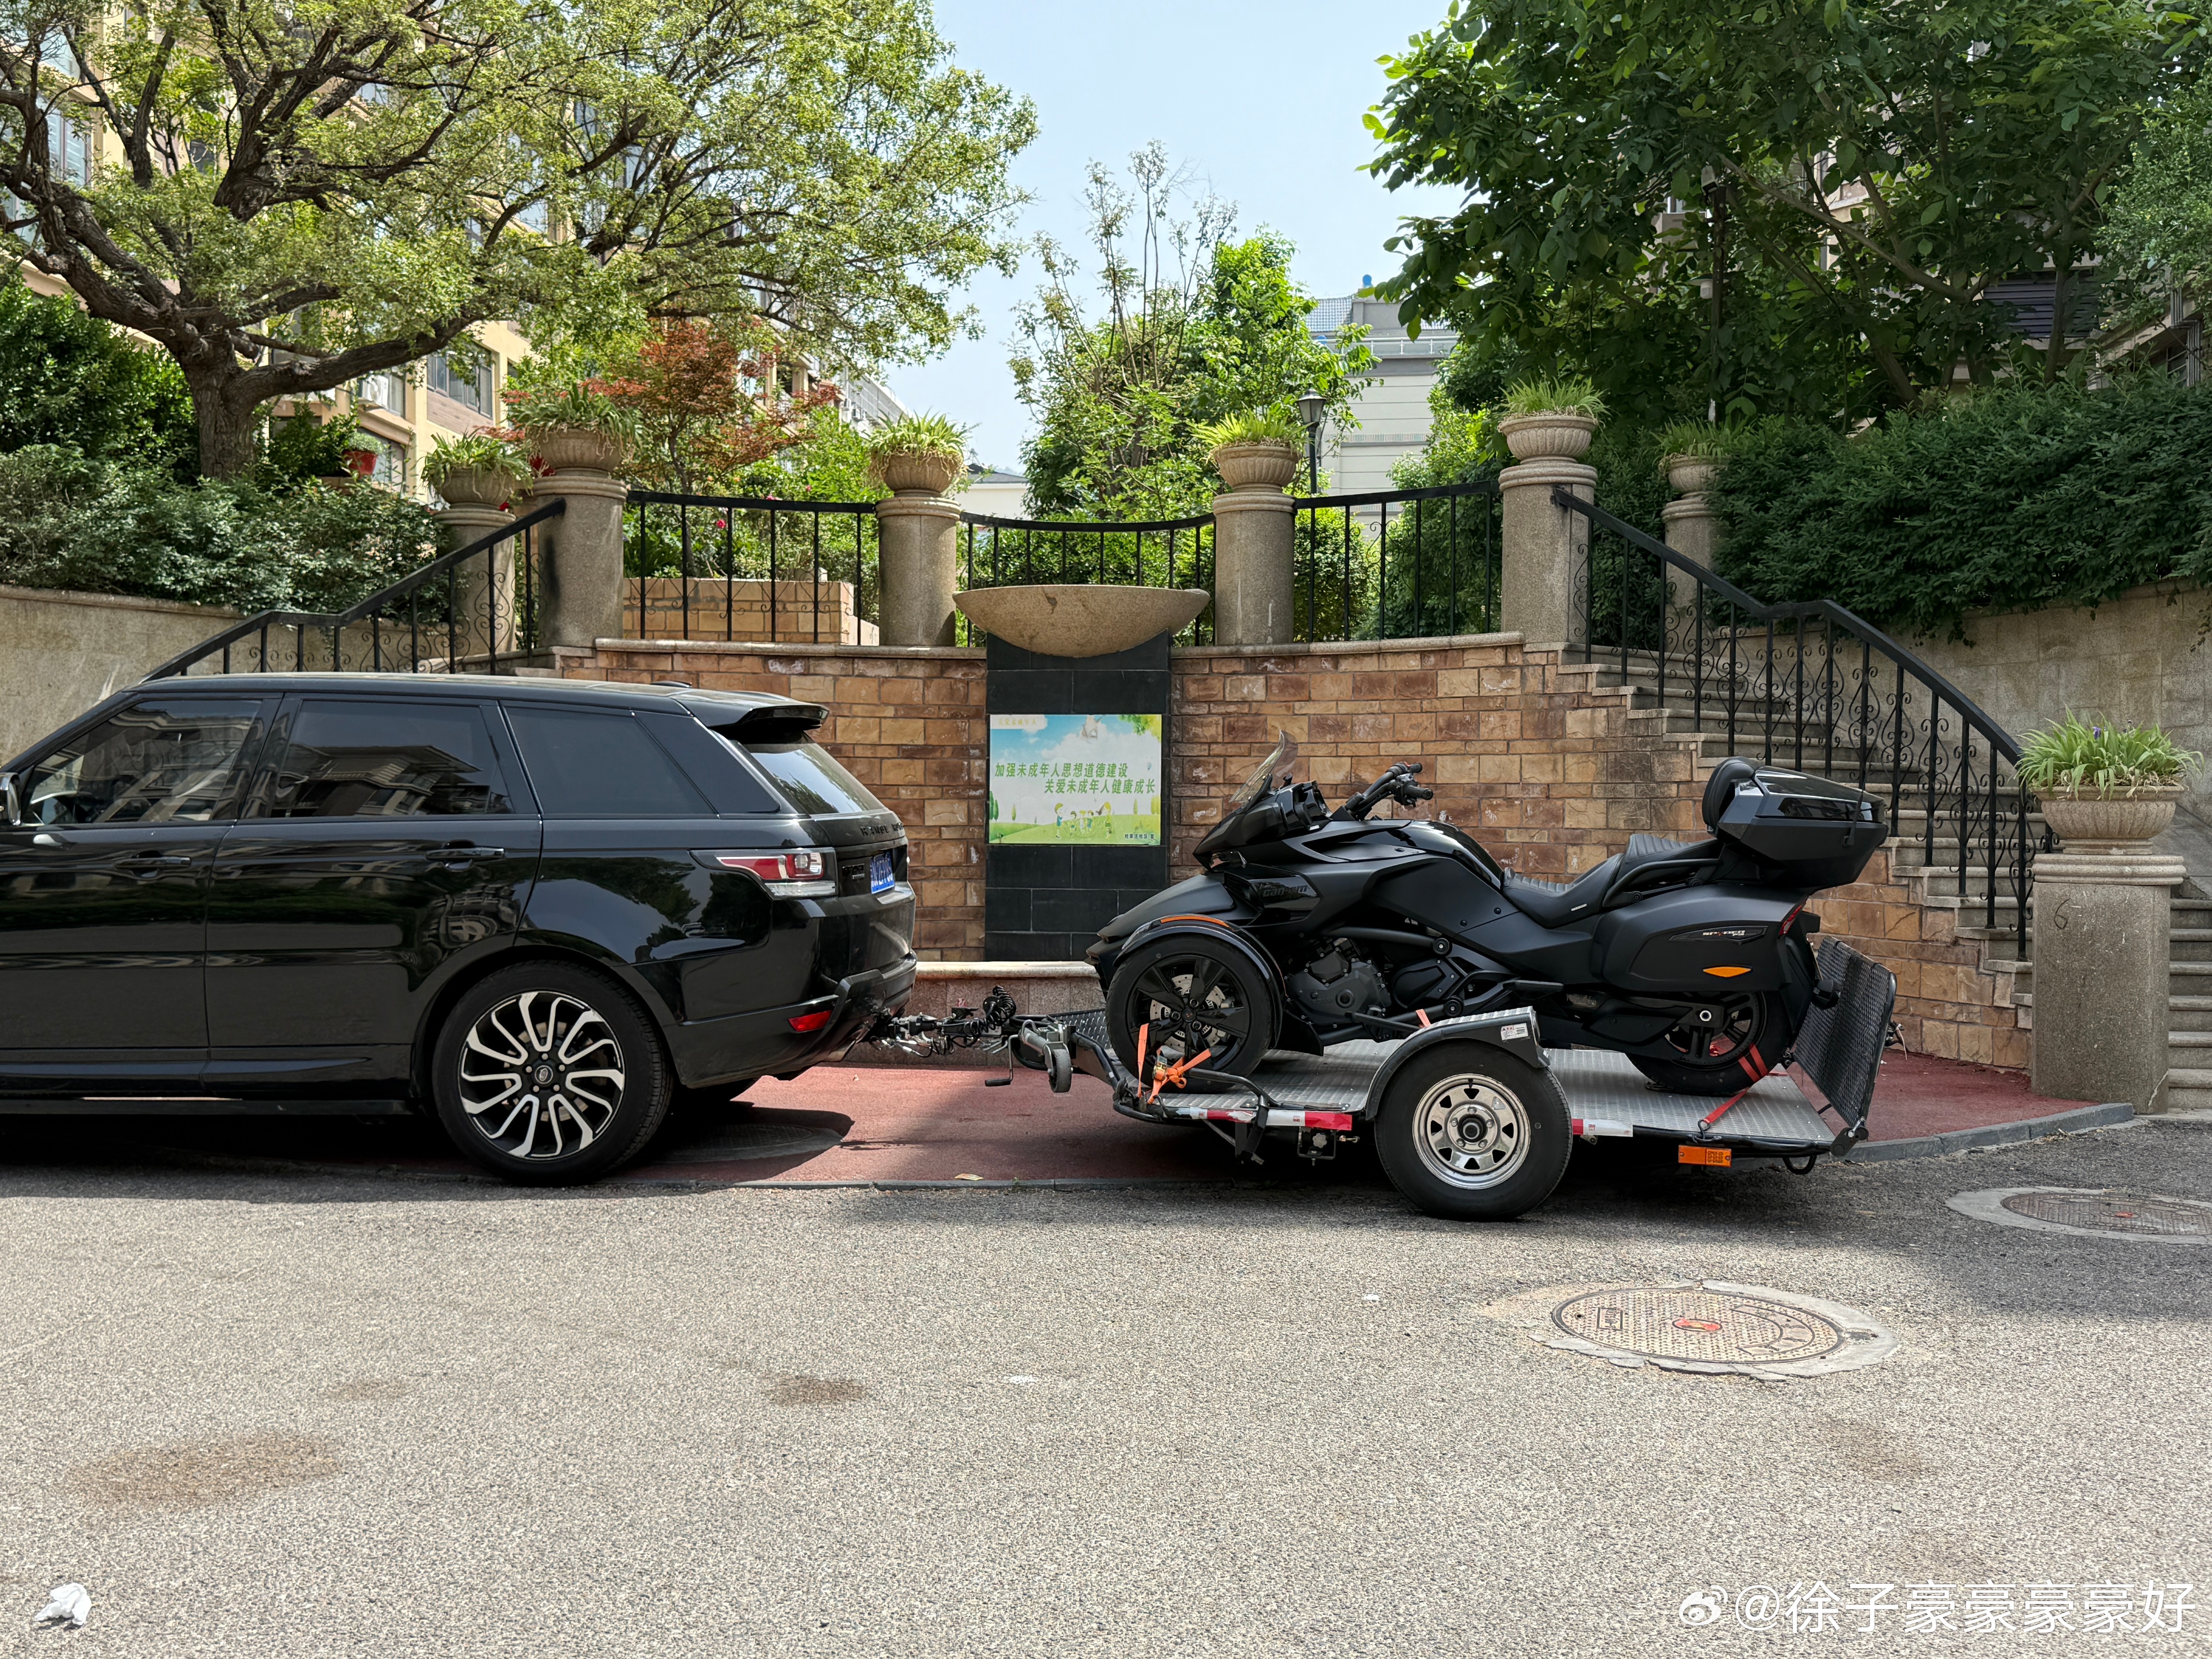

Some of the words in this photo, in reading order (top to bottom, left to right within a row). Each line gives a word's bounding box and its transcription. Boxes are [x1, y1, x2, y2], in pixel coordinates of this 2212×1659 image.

[994, 762, 1128, 778] 加强未成年人思想道德建设
[1044, 778, 1156, 794] 关爱未成年人健康成长
